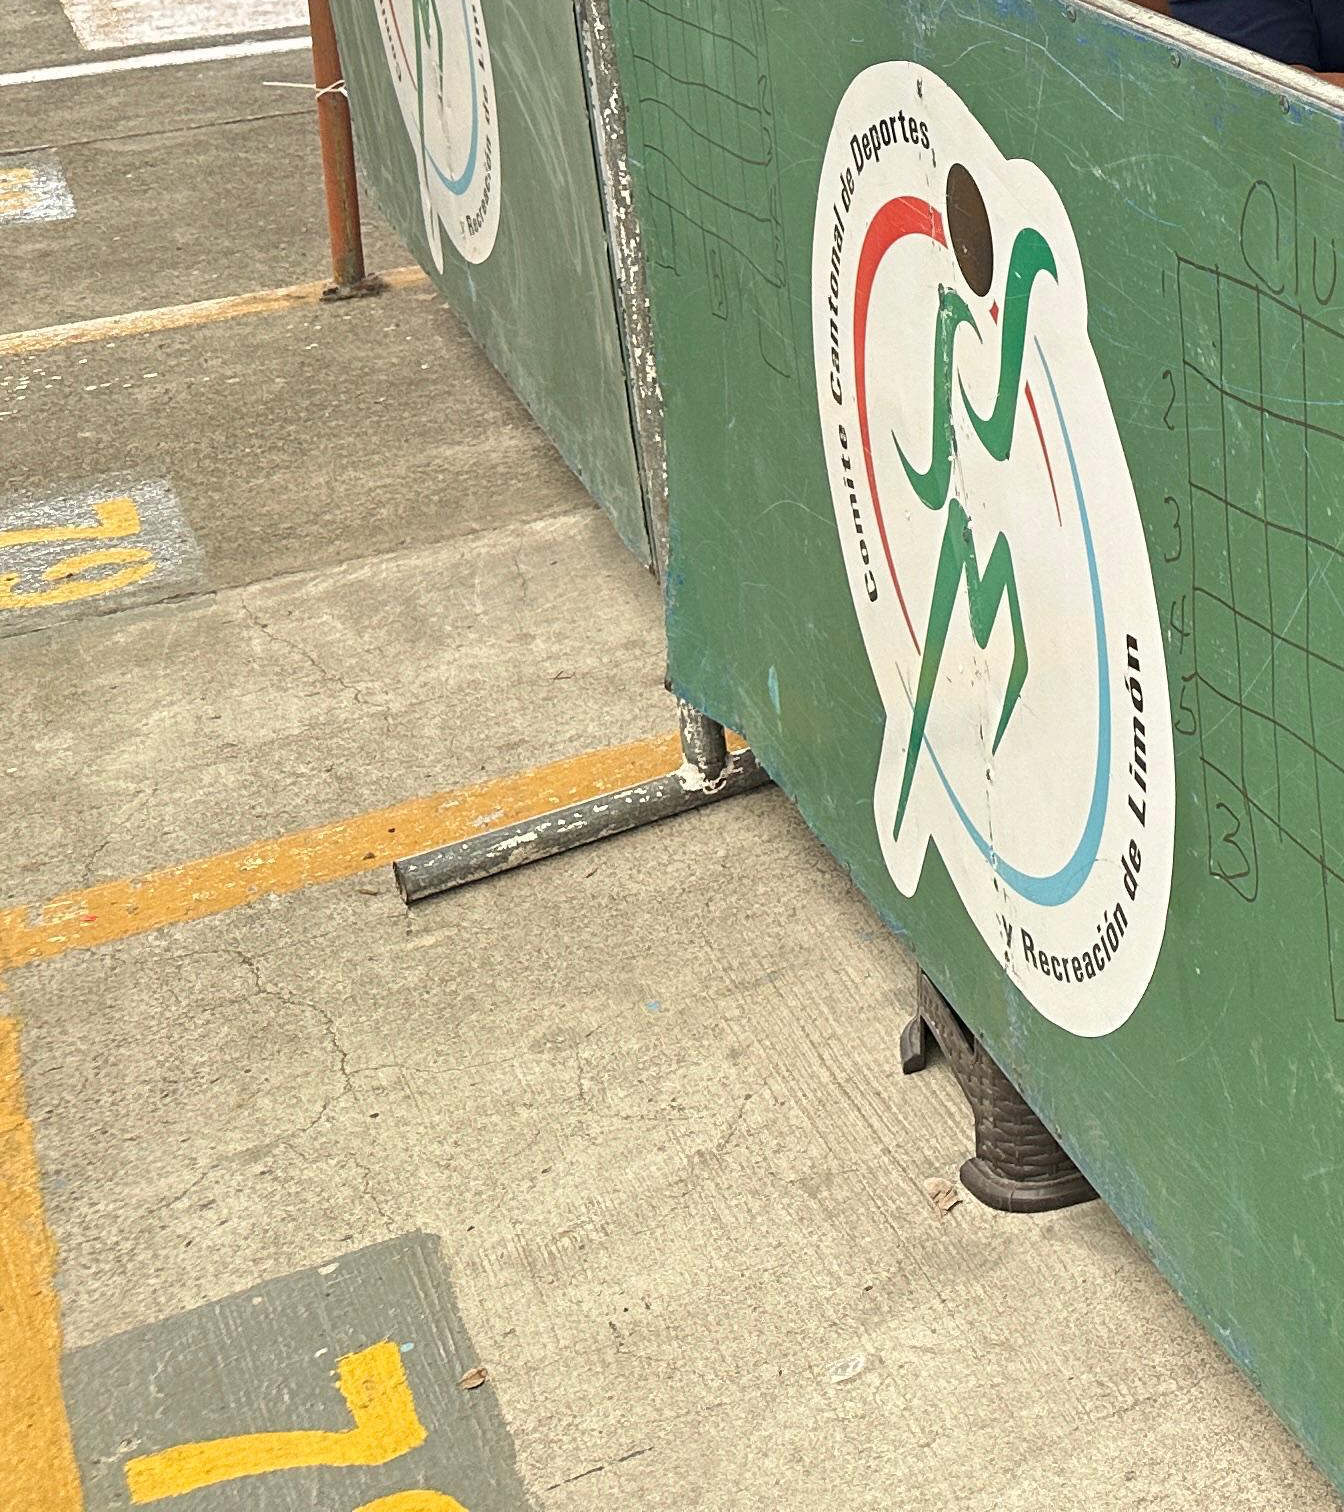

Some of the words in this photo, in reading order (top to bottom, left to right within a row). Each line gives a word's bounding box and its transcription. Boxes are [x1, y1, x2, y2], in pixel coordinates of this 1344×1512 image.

[849, 109, 931, 177] Deportes
[839, 167, 855, 214] de
[827, 203, 846, 406] Cantonal
[838, 424, 878, 602] Comite
[1124, 633, 1147, 829] Limón
[1120, 838, 1142, 903] de
[1020, 901, 1128, 985] Recreación
